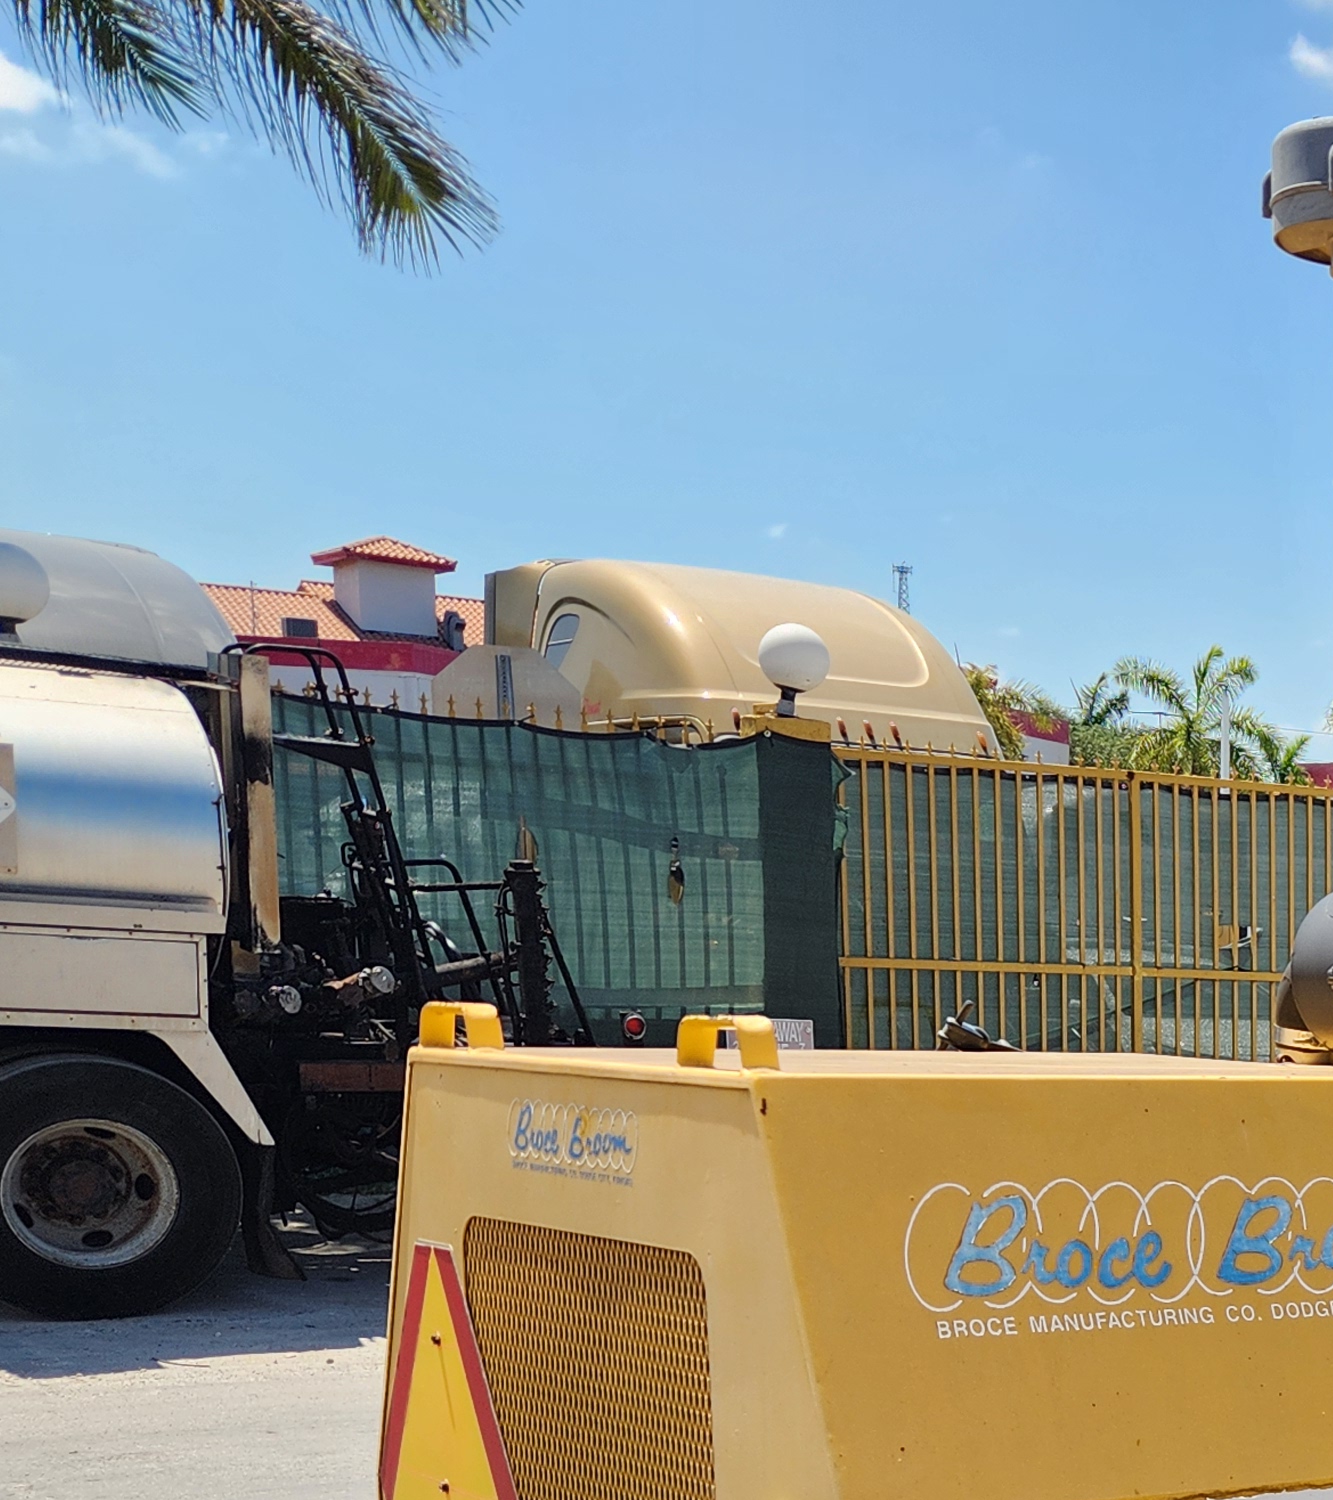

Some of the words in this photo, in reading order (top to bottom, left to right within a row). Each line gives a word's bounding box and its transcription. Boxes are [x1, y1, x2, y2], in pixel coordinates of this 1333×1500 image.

[514, 1104, 559, 1155] Broce
[944, 1194, 1172, 1297] Broce
[936, 1316, 1018, 1339] BROCE
[1029, 1307, 1215, 1334] MANUFACTURING
[1225, 1304, 1263, 1323] CO.
